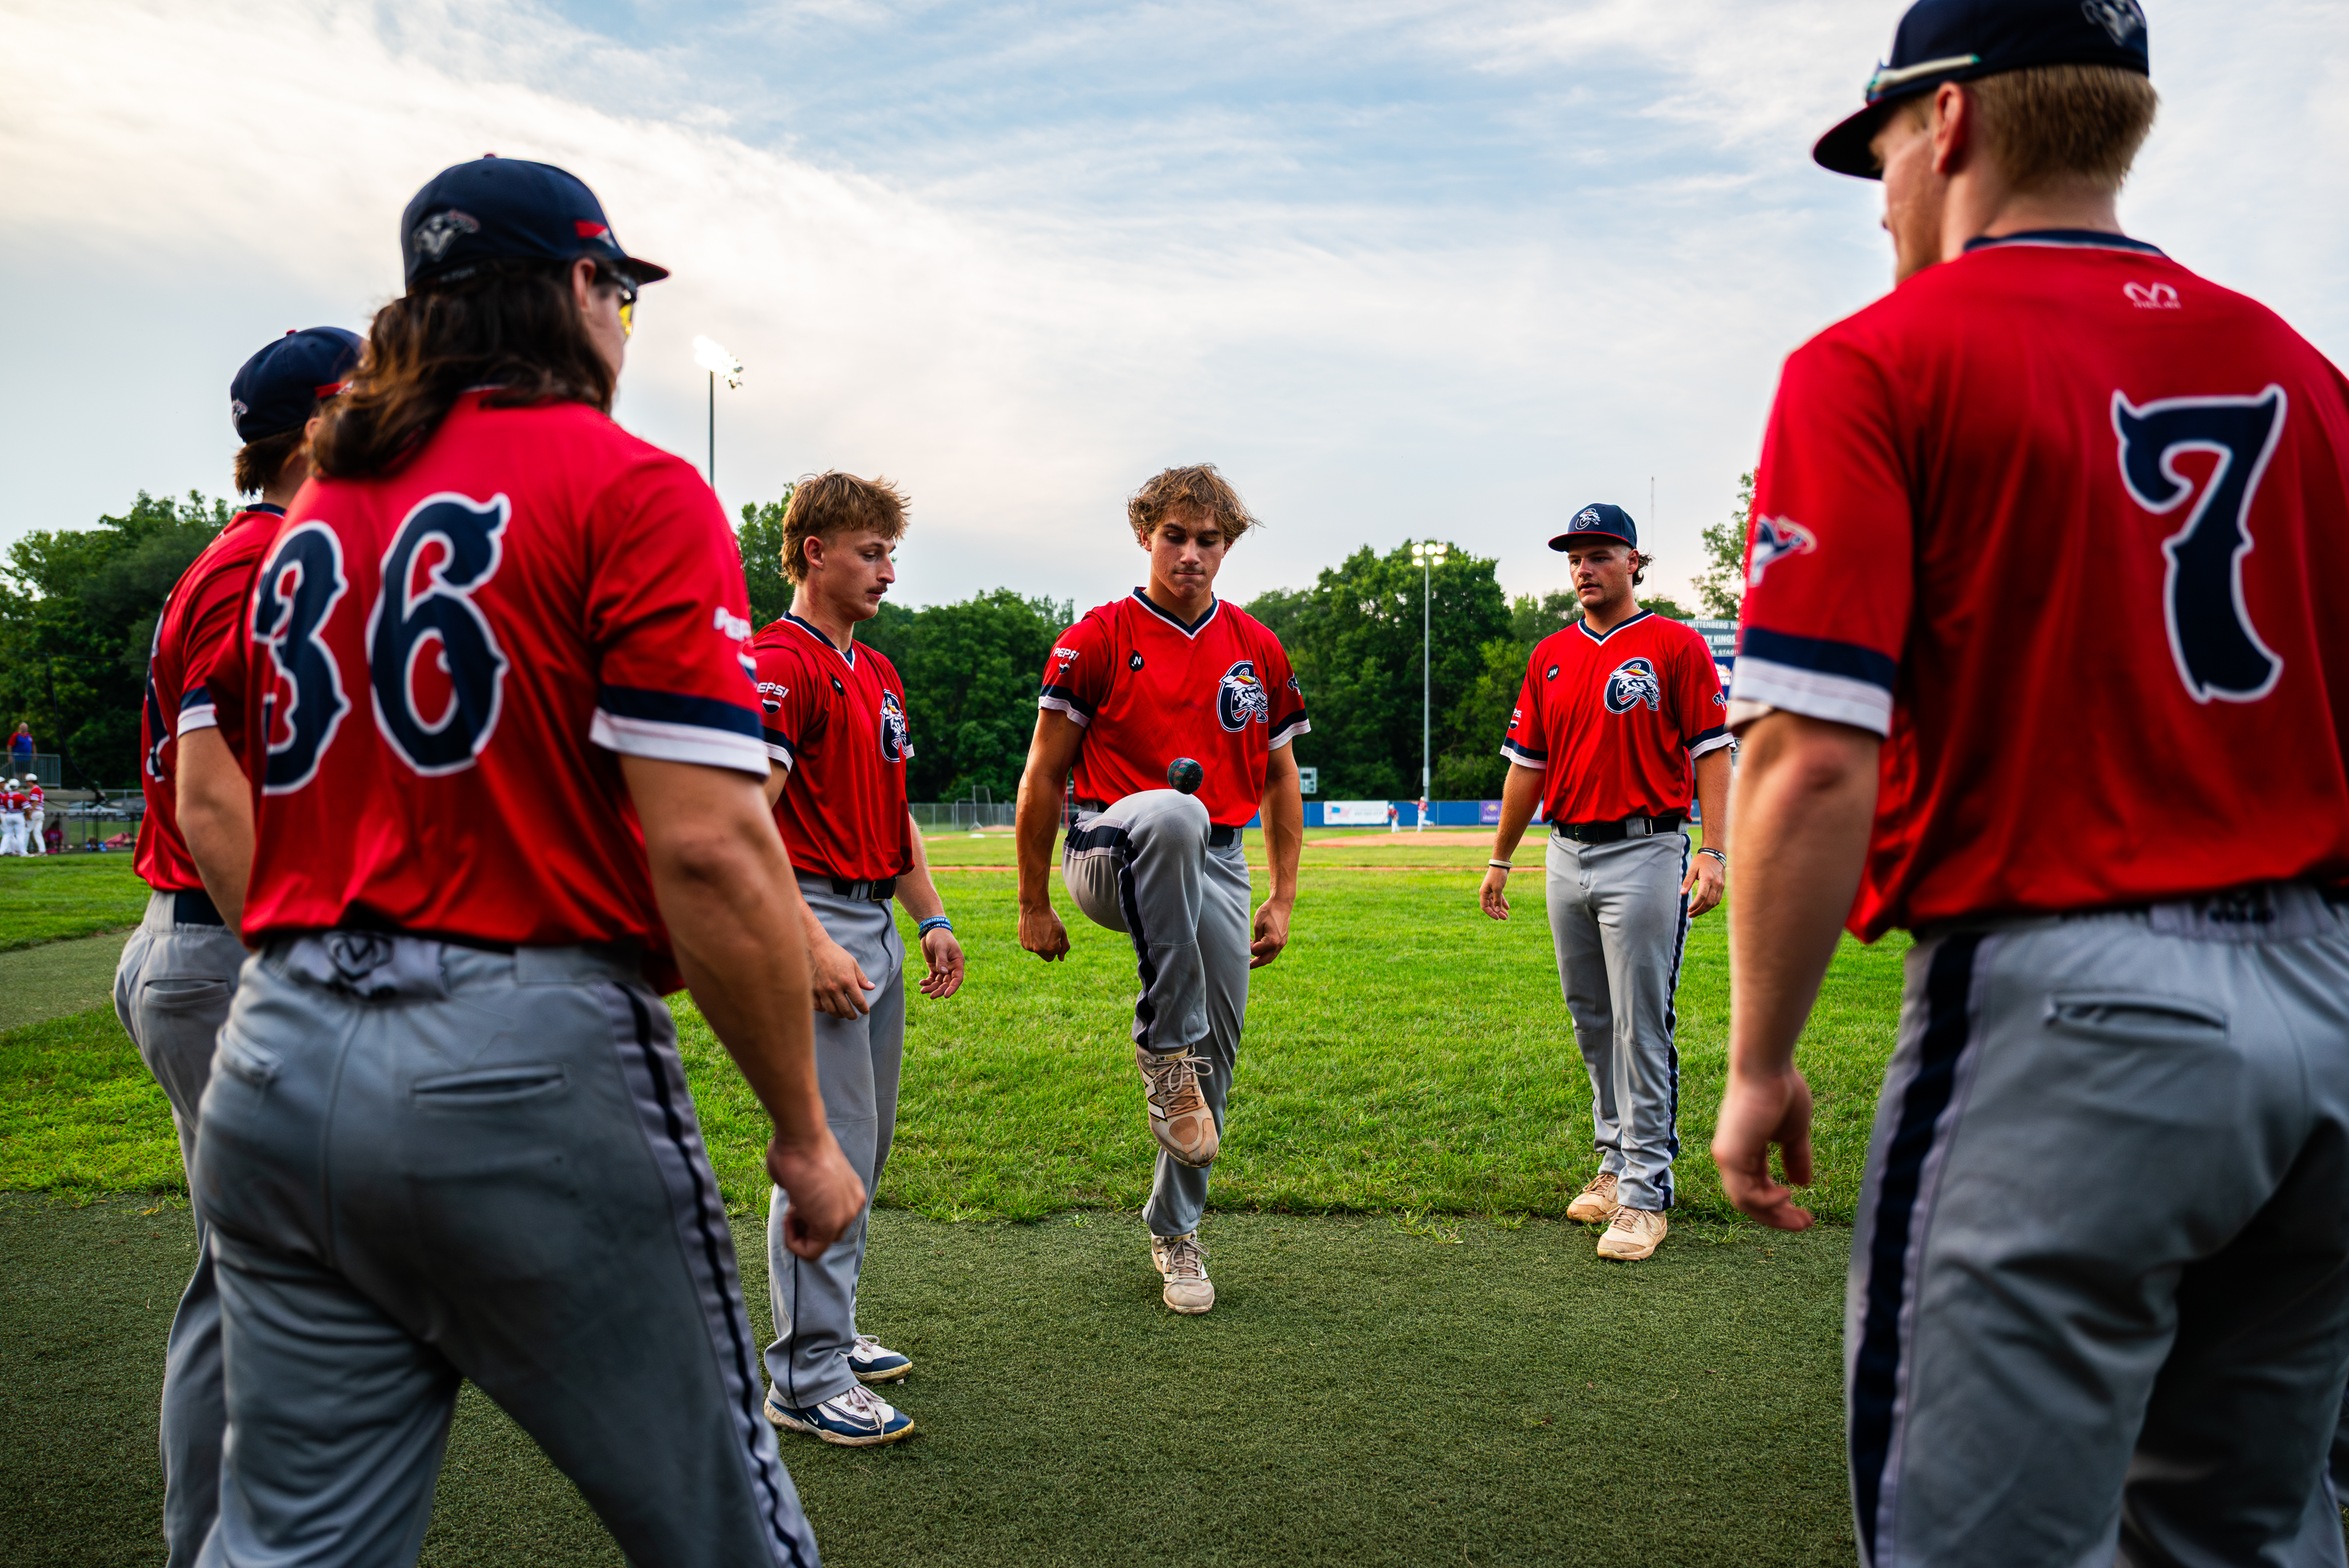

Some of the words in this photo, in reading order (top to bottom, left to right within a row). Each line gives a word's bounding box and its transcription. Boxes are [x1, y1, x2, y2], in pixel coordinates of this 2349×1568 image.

[2110, 383, 2288, 704] 7
[1685, 620, 1729, 630] WITTENBERG
[252, 491, 512, 796] 36
[1713, 634, 1736, 645] KINGS
[1053, 647, 1080, 661] PEPSI
[1547, 667, 1559, 679] JW
[756, 681, 790, 699] EPSI
